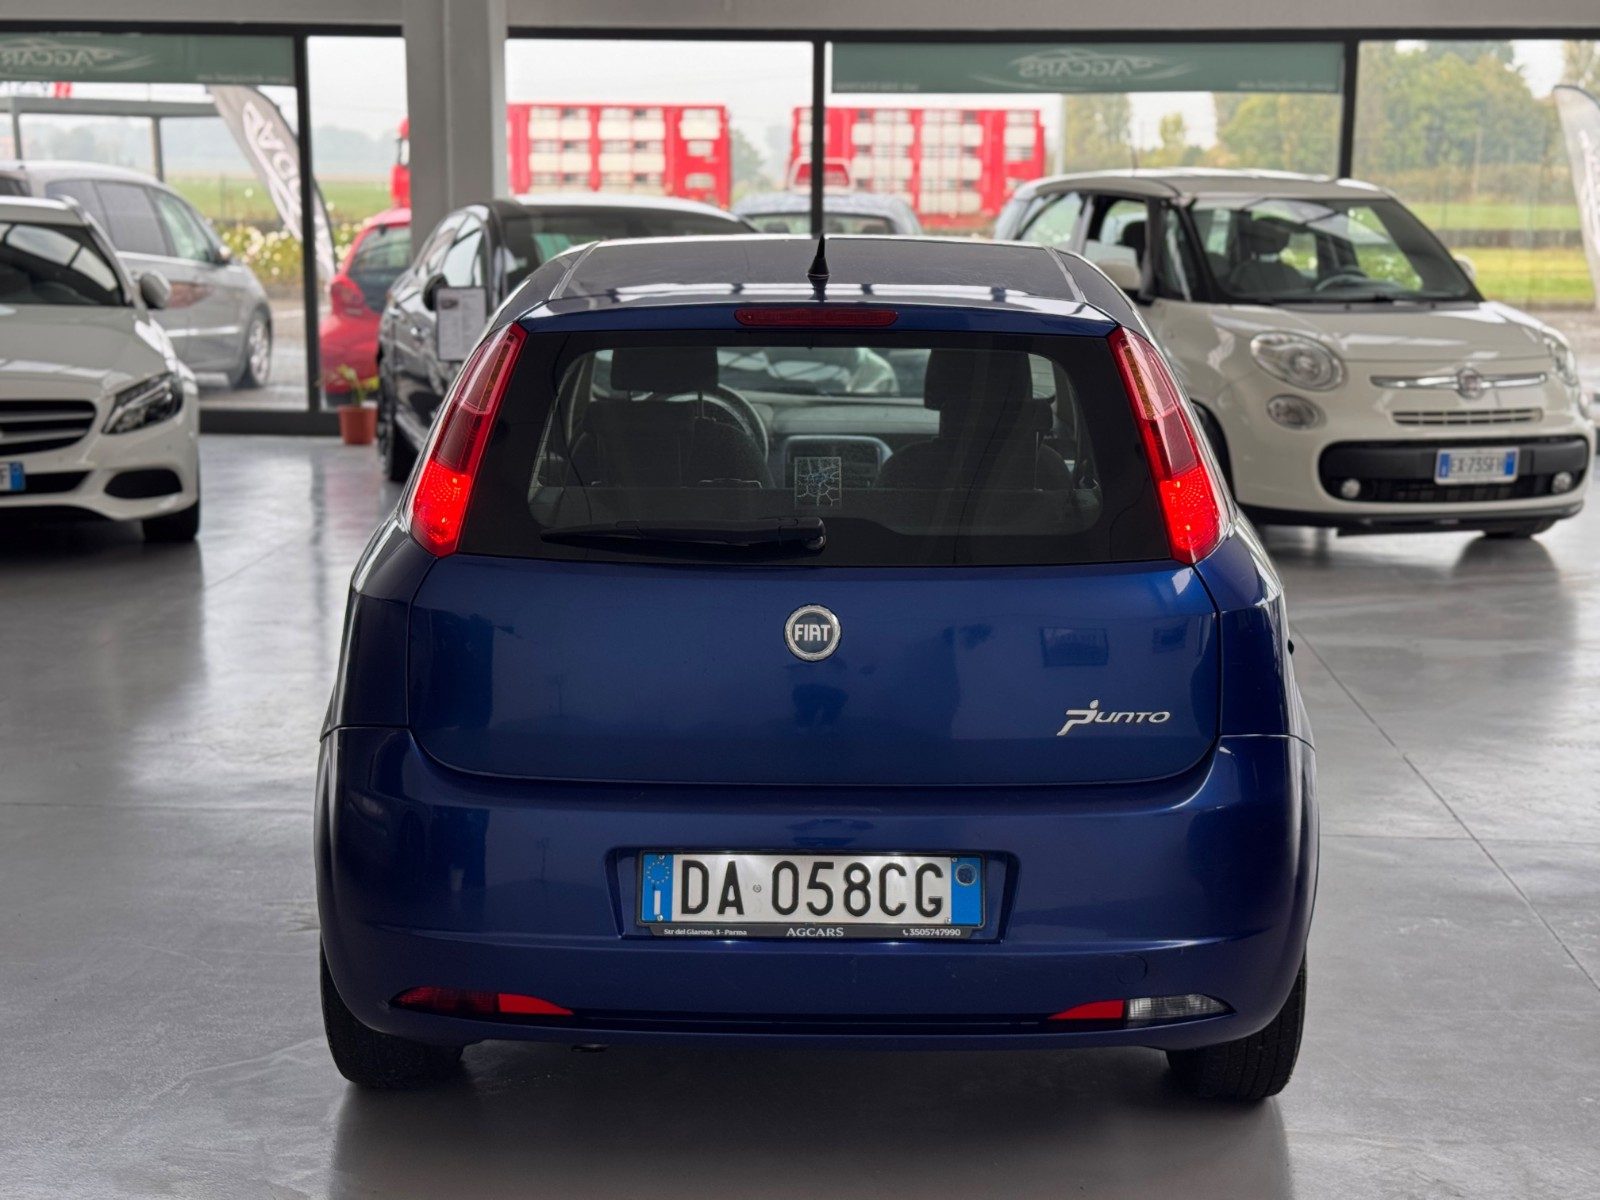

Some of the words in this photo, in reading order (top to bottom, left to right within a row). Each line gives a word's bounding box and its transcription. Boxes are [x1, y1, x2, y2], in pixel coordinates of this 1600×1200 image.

[794, 623, 831, 642] FIAT
[681, 859, 745, 915] DA
[771, 860, 944, 918] 058CG
[786, 927, 844, 937] AGCARS
[910, 928, 961, 937] 3505747990
